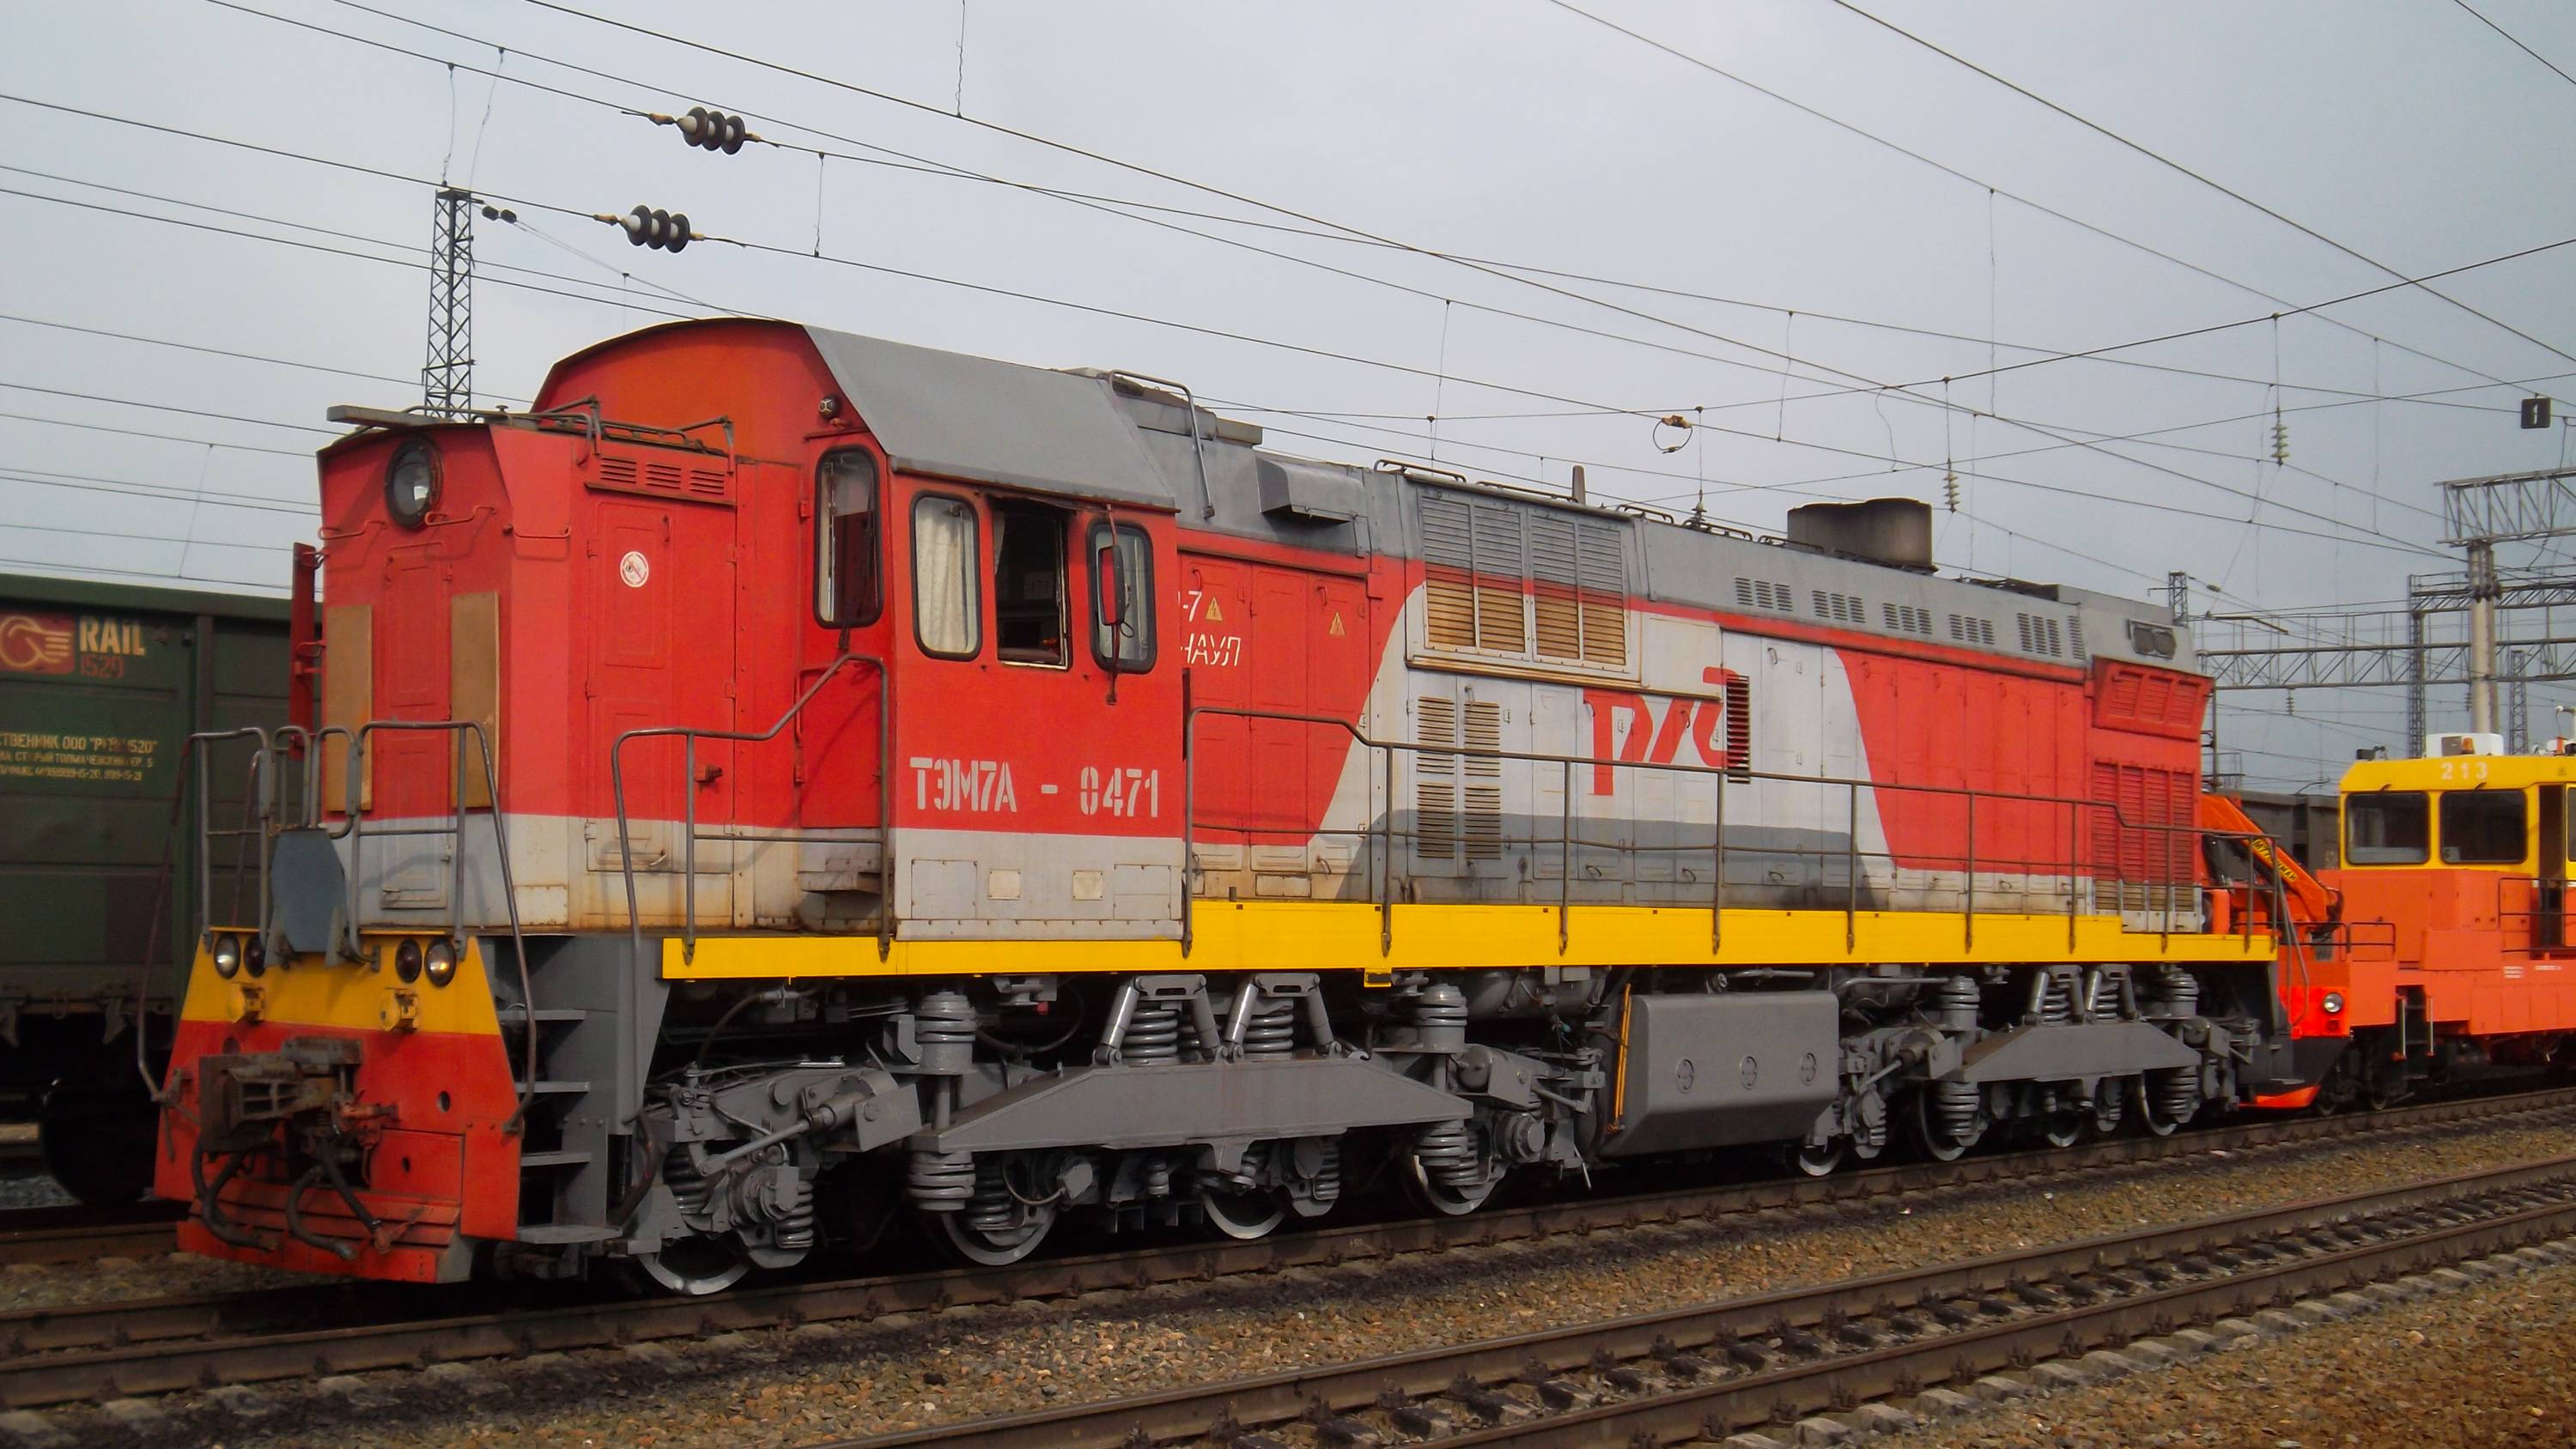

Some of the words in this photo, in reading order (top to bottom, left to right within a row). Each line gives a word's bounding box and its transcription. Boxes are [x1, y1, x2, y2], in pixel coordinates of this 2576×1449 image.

[79, 615, 146, 656] RAIL
[909, 756, 1018, 812] ТЭМ7А
[1080, 766, 1158, 818] 0471
[2440, 762, 2488, 780] 213
